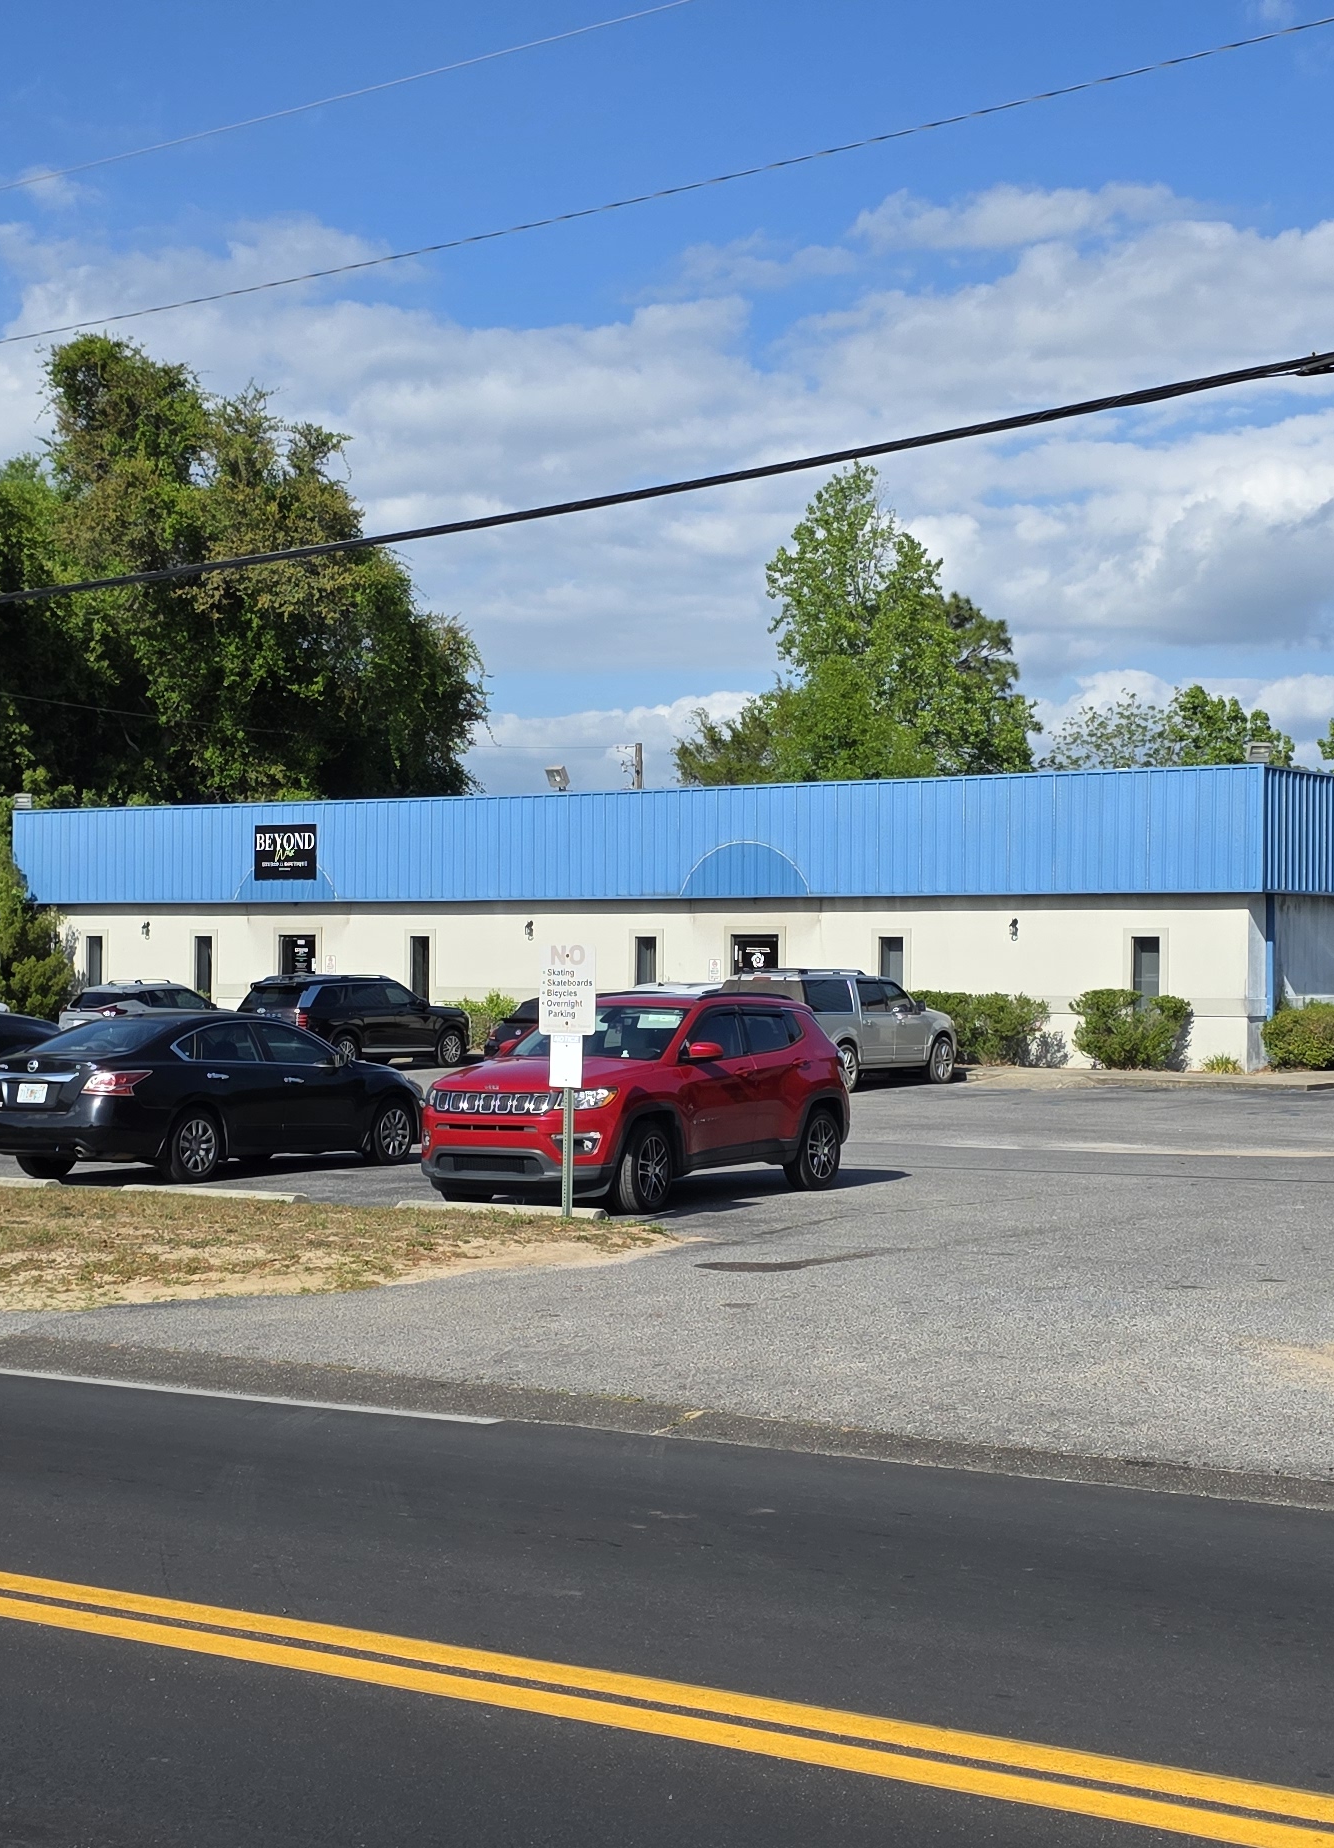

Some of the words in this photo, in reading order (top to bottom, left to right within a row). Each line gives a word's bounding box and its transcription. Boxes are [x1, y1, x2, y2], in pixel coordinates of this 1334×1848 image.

[256, 833, 315, 850] BEYOND
[550, 945, 585, 965] NO
[547, 969, 575, 978] Skating
[547, 979, 593, 987] Skateboards
[547, 989, 577, 998] Bicycles
[547, 1000, 583, 1009] Overnight
[548, 1010, 576, 1019] Parking
